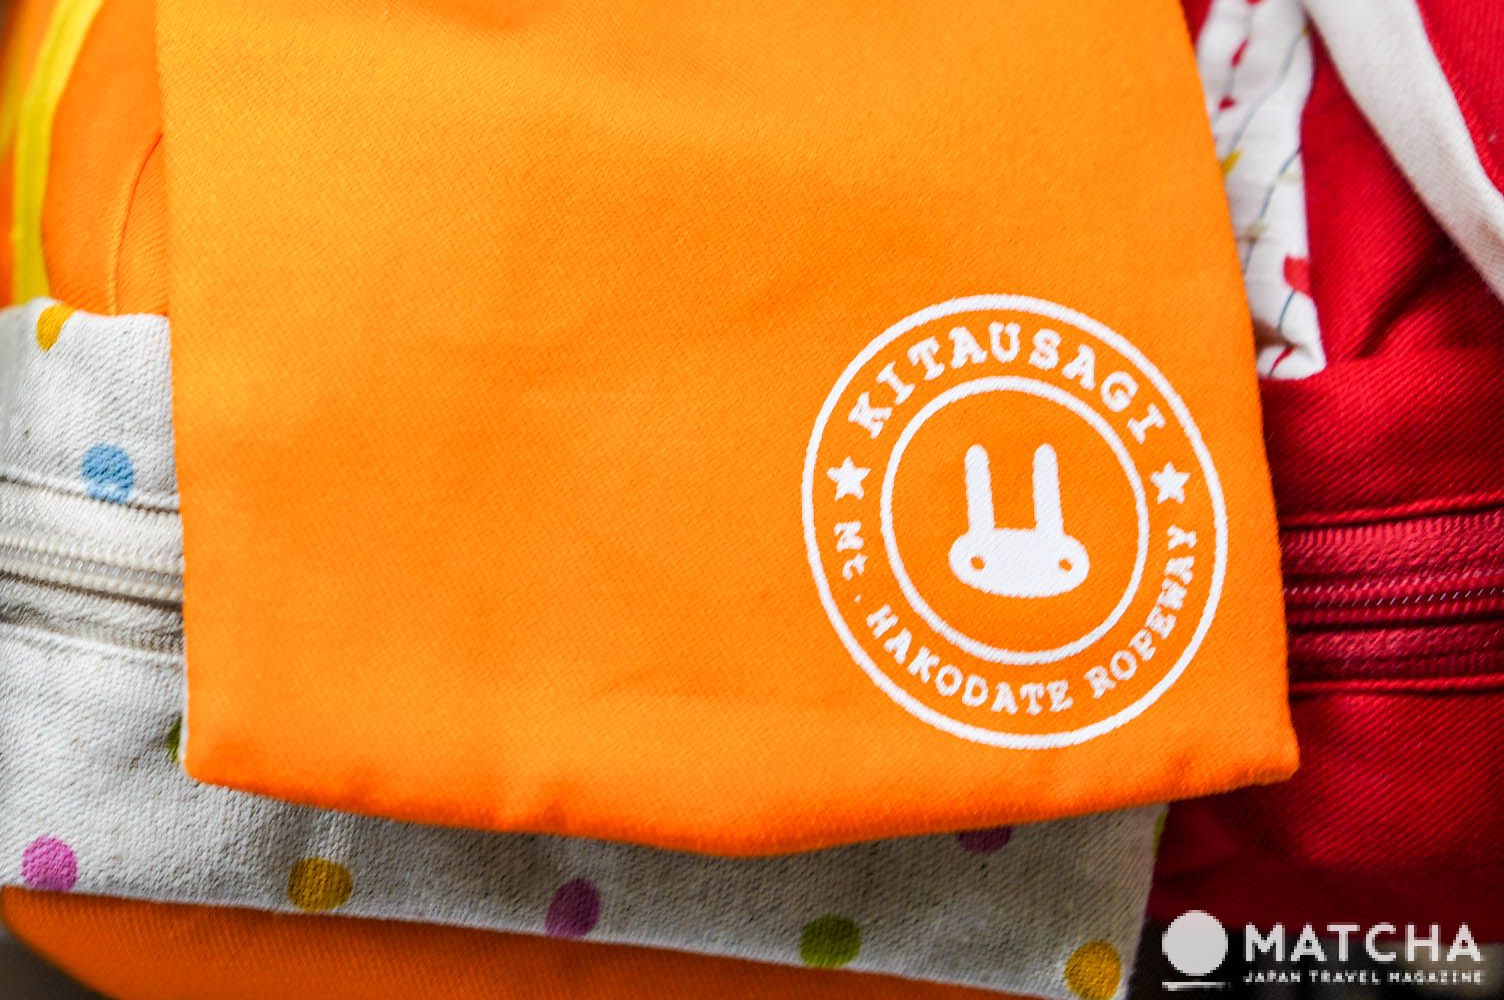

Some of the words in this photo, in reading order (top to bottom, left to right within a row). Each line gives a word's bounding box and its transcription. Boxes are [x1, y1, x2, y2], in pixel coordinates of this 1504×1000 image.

[848, 323, 1165, 444] KITAUSAGI
[867, 605, 1073, 715] HAKODATE
[1084, 525, 1196, 699] ROPEWAY
